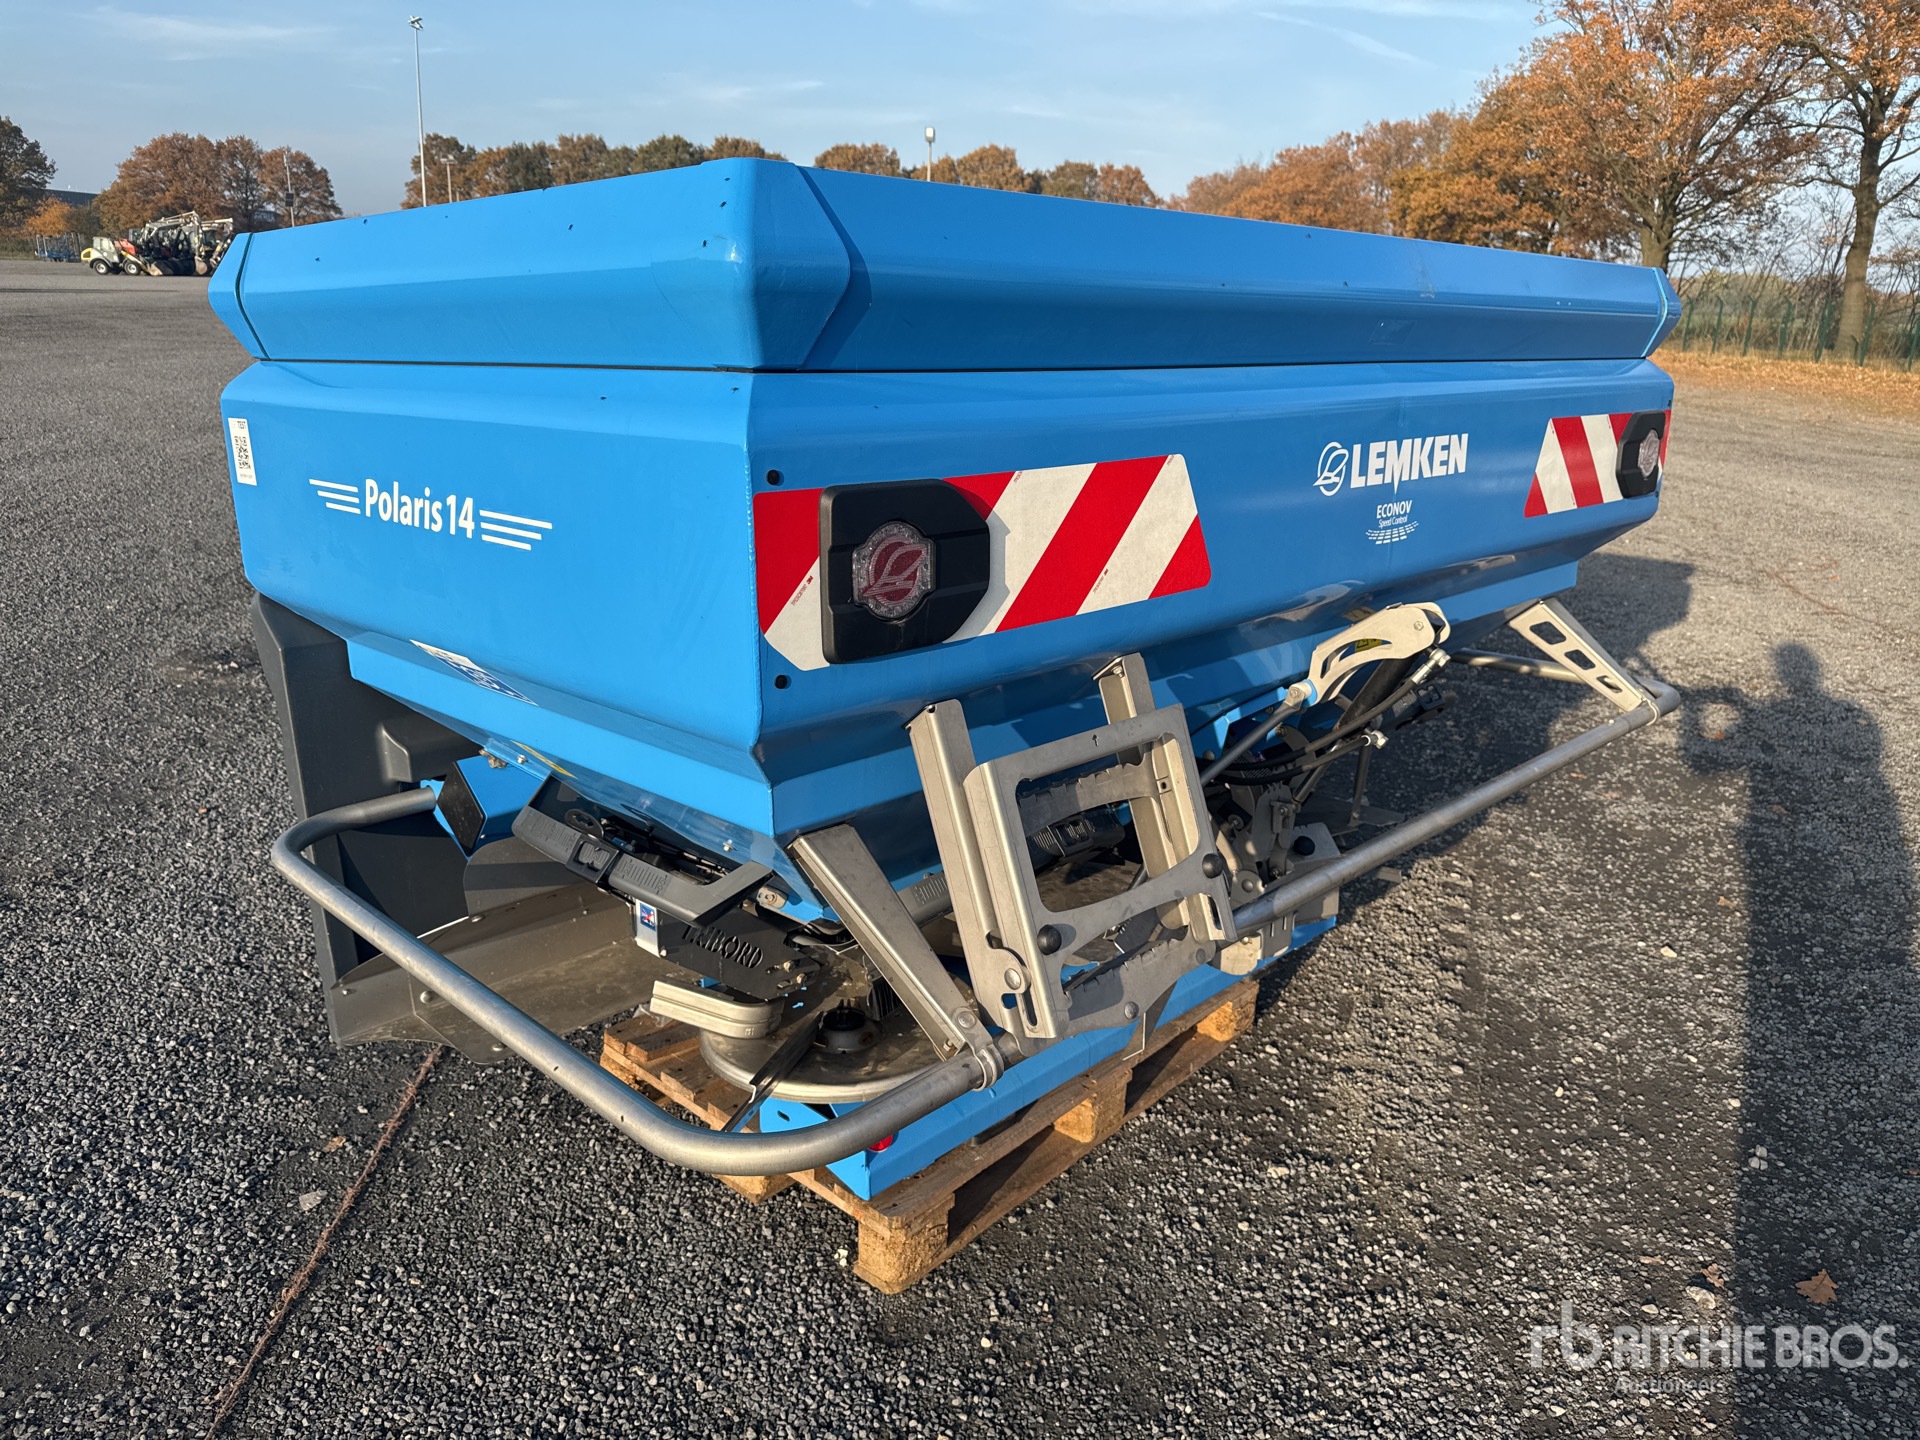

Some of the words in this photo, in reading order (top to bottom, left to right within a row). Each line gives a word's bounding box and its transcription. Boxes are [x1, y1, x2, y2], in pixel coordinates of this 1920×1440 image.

[1350, 433, 1469, 494] LEMKEN
[365, 478, 443, 533] Polaris
[446, 494, 475, 538] 14
[1376, 500, 1412, 519] ECONOV
